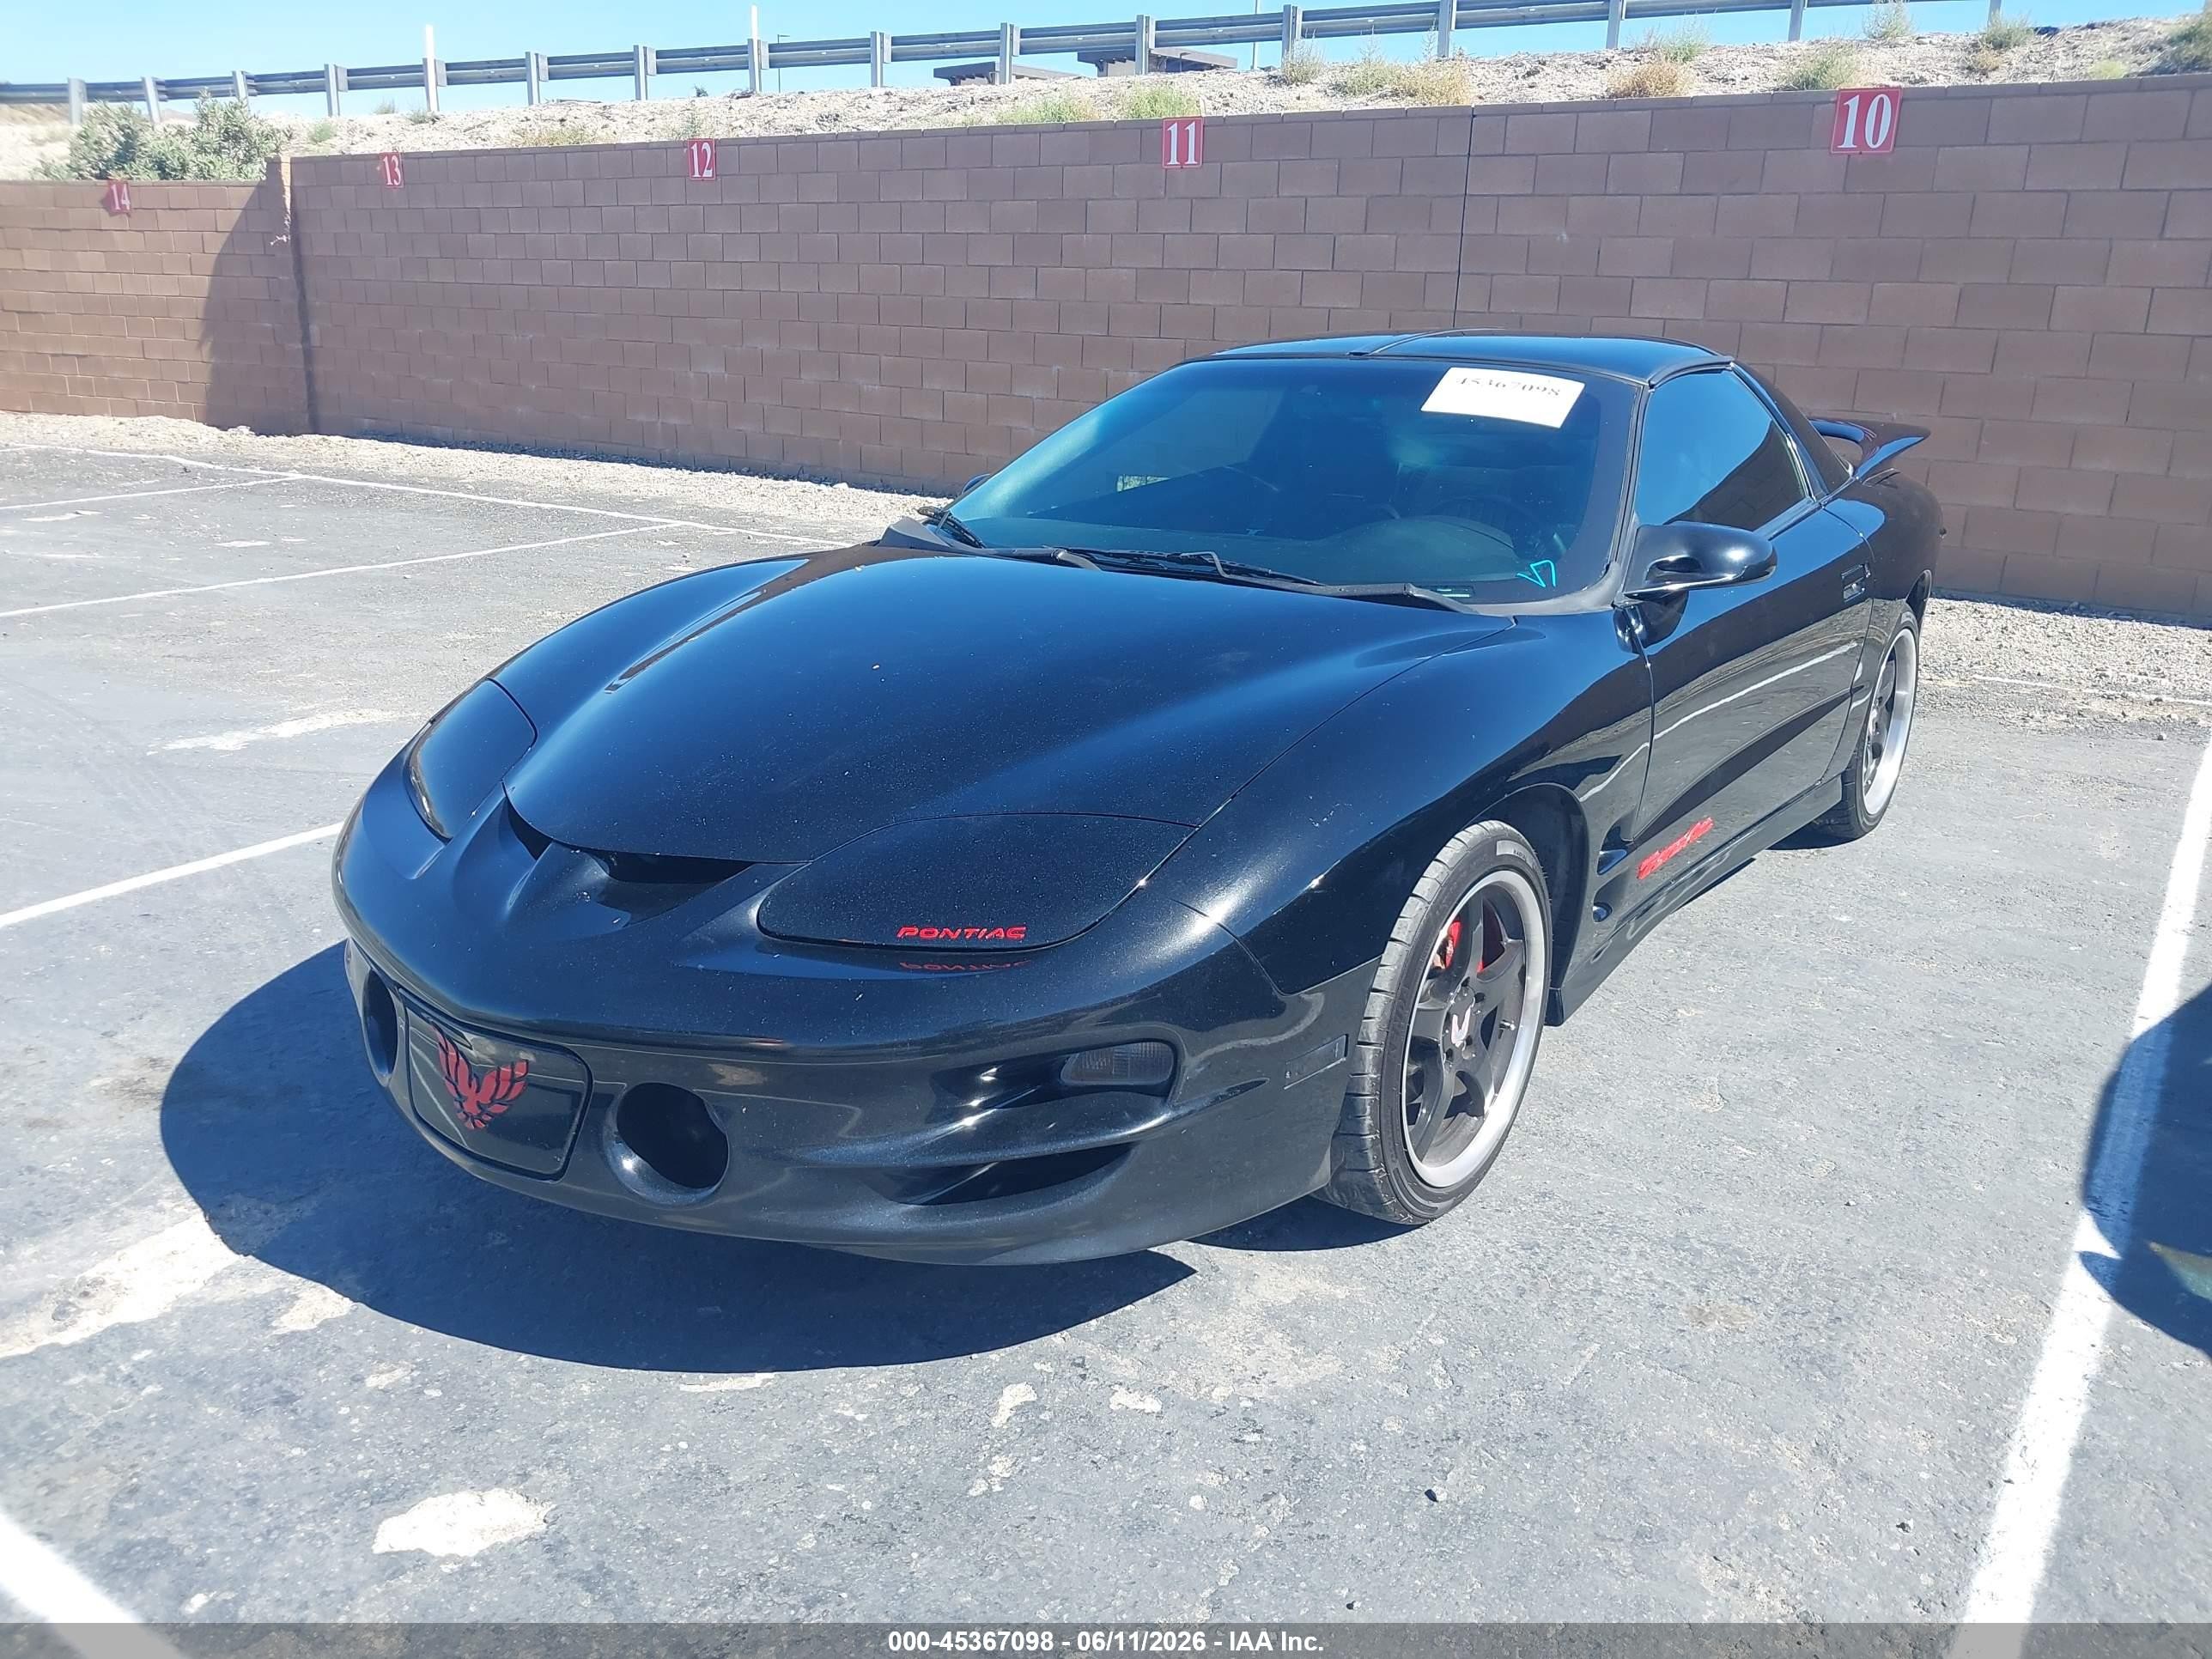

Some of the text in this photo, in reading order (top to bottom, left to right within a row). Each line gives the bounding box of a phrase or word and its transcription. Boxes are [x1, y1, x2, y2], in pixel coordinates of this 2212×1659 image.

[1837, 94, 1892, 149] 10
[690, 142, 713, 178] 12
[1166, 121, 1199, 166] 11
[383, 155, 401, 185] 13
[110, 183, 131, 210] 14
[896, 926, 1027, 940] PONTIAC
